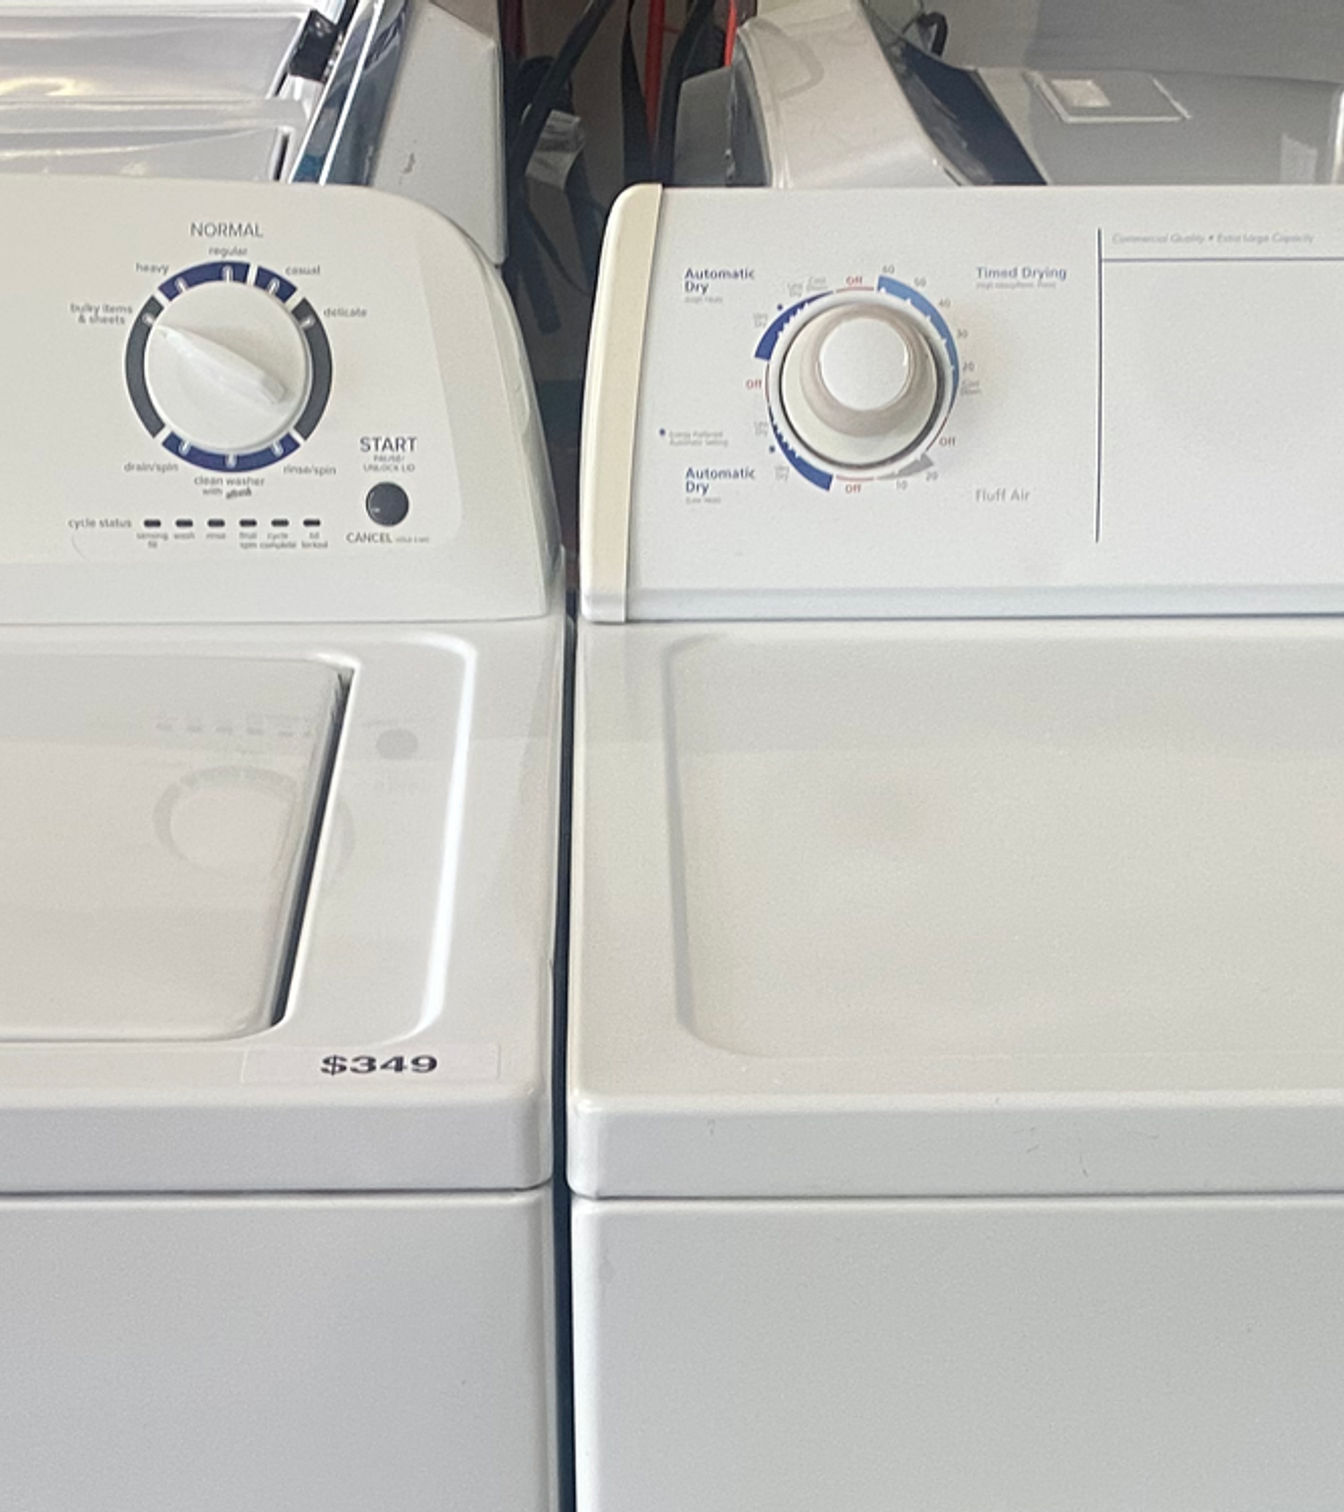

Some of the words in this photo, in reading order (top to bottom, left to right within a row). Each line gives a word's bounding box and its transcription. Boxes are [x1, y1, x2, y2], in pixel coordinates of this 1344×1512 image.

[191, 222, 263, 238] NORMAL
[208, 247, 248, 257] regular
[136, 263, 169, 276] heavy
[285, 265, 320, 275] casual
[684, 267, 755, 280] Automatic
[882, 265, 895, 274] 60
[976, 267, 1017, 279] Timed
[1022, 267, 1067, 281] Drying
[846, 276, 862, 286] Off
[685, 281, 709, 294] Dry
[70, 303, 100, 316] bulky
[103, 304, 133, 314] items
[323, 307, 367, 318] delicate
[89, 314, 125, 325] sheets
[745, 378, 762, 389] Off
[360, 437, 417, 452] START
[939, 437, 956, 446] Off
[124, 462, 178, 474] drain/spin
[283, 463, 336, 476] rinse/spin
[363, 463, 398, 472] UNLOCK
[401, 463, 415, 472] LID
[686, 467, 755, 480] Automatic
[194, 475, 224, 486] clean
[226, 475, 264, 486] washer
[686, 481, 709, 496] Dry
[845, 483, 862, 494] Off
[976, 489, 1006, 502] Fluff
[1010, 489, 1031, 502] Air
[67, 518, 96, 529] cycle
[99, 518, 133, 528] status
[346, 532, 392, 543] CANCEL
[320, 1055, 438, 1076] $349
